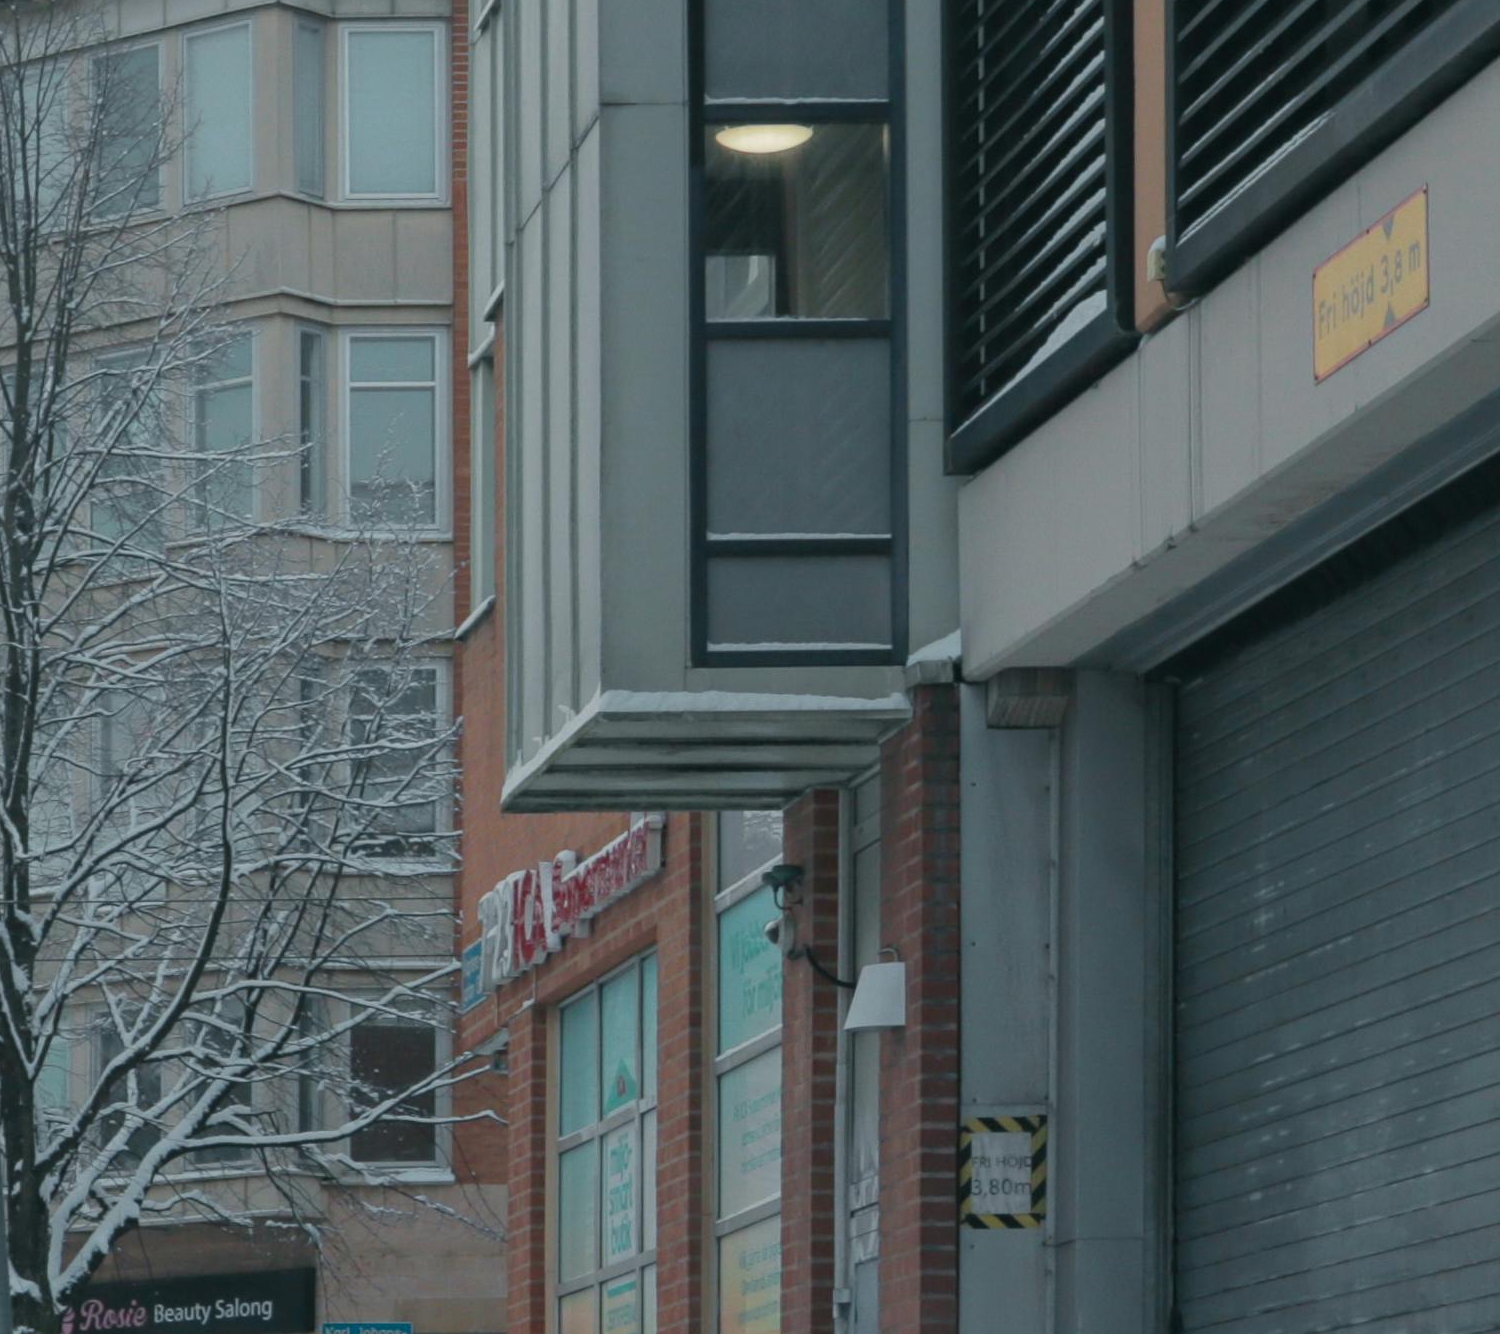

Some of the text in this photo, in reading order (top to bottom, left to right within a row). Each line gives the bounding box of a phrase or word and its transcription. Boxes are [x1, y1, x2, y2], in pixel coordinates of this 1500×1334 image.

[79, 1298, 273, 1331] Rosie Beauty Salong
